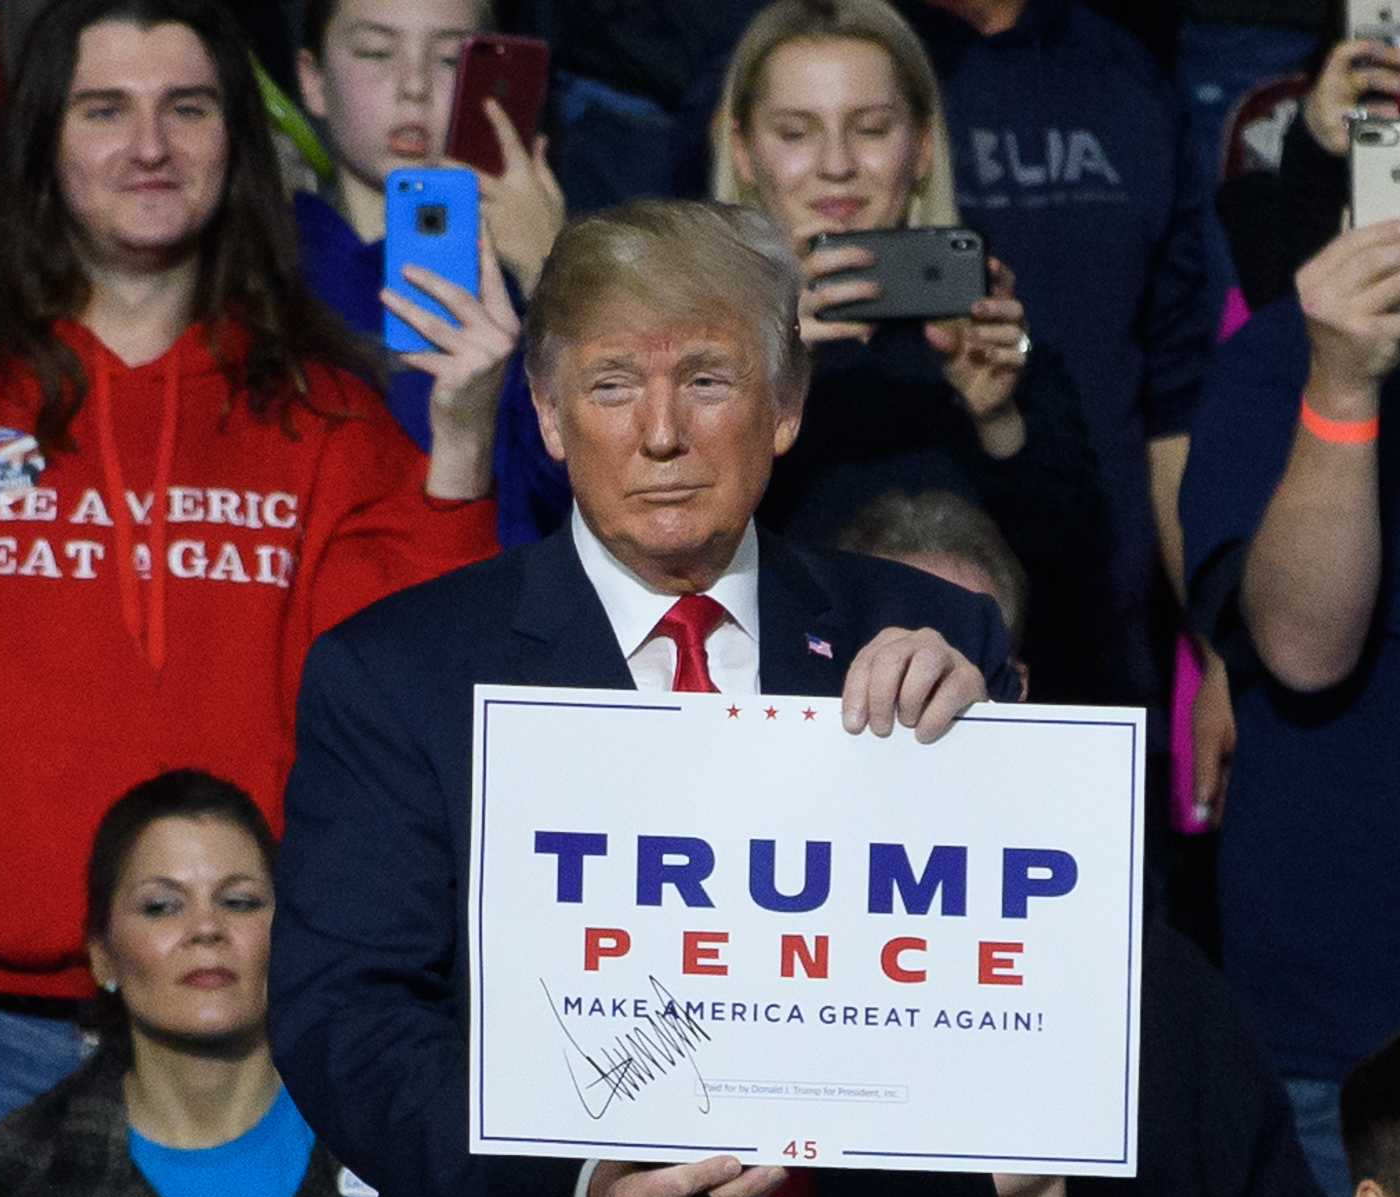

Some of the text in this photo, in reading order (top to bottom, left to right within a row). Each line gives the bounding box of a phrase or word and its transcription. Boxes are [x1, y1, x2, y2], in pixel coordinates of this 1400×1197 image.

[534, 830, 1079, 919] TRUMP
[583, 927, 1025, 985] PENCE
[564, 996, 1045, 1031] MAKE AMERICA GREAT AGAIN!
[724, 1083, 736, 1093] for
[751, 1084, 783, 1095] Donald
[793, 1085, 822, 1097] Trump
[823, 1086, 836, 1096] for
[782, 1140, 818, 1159] 45
